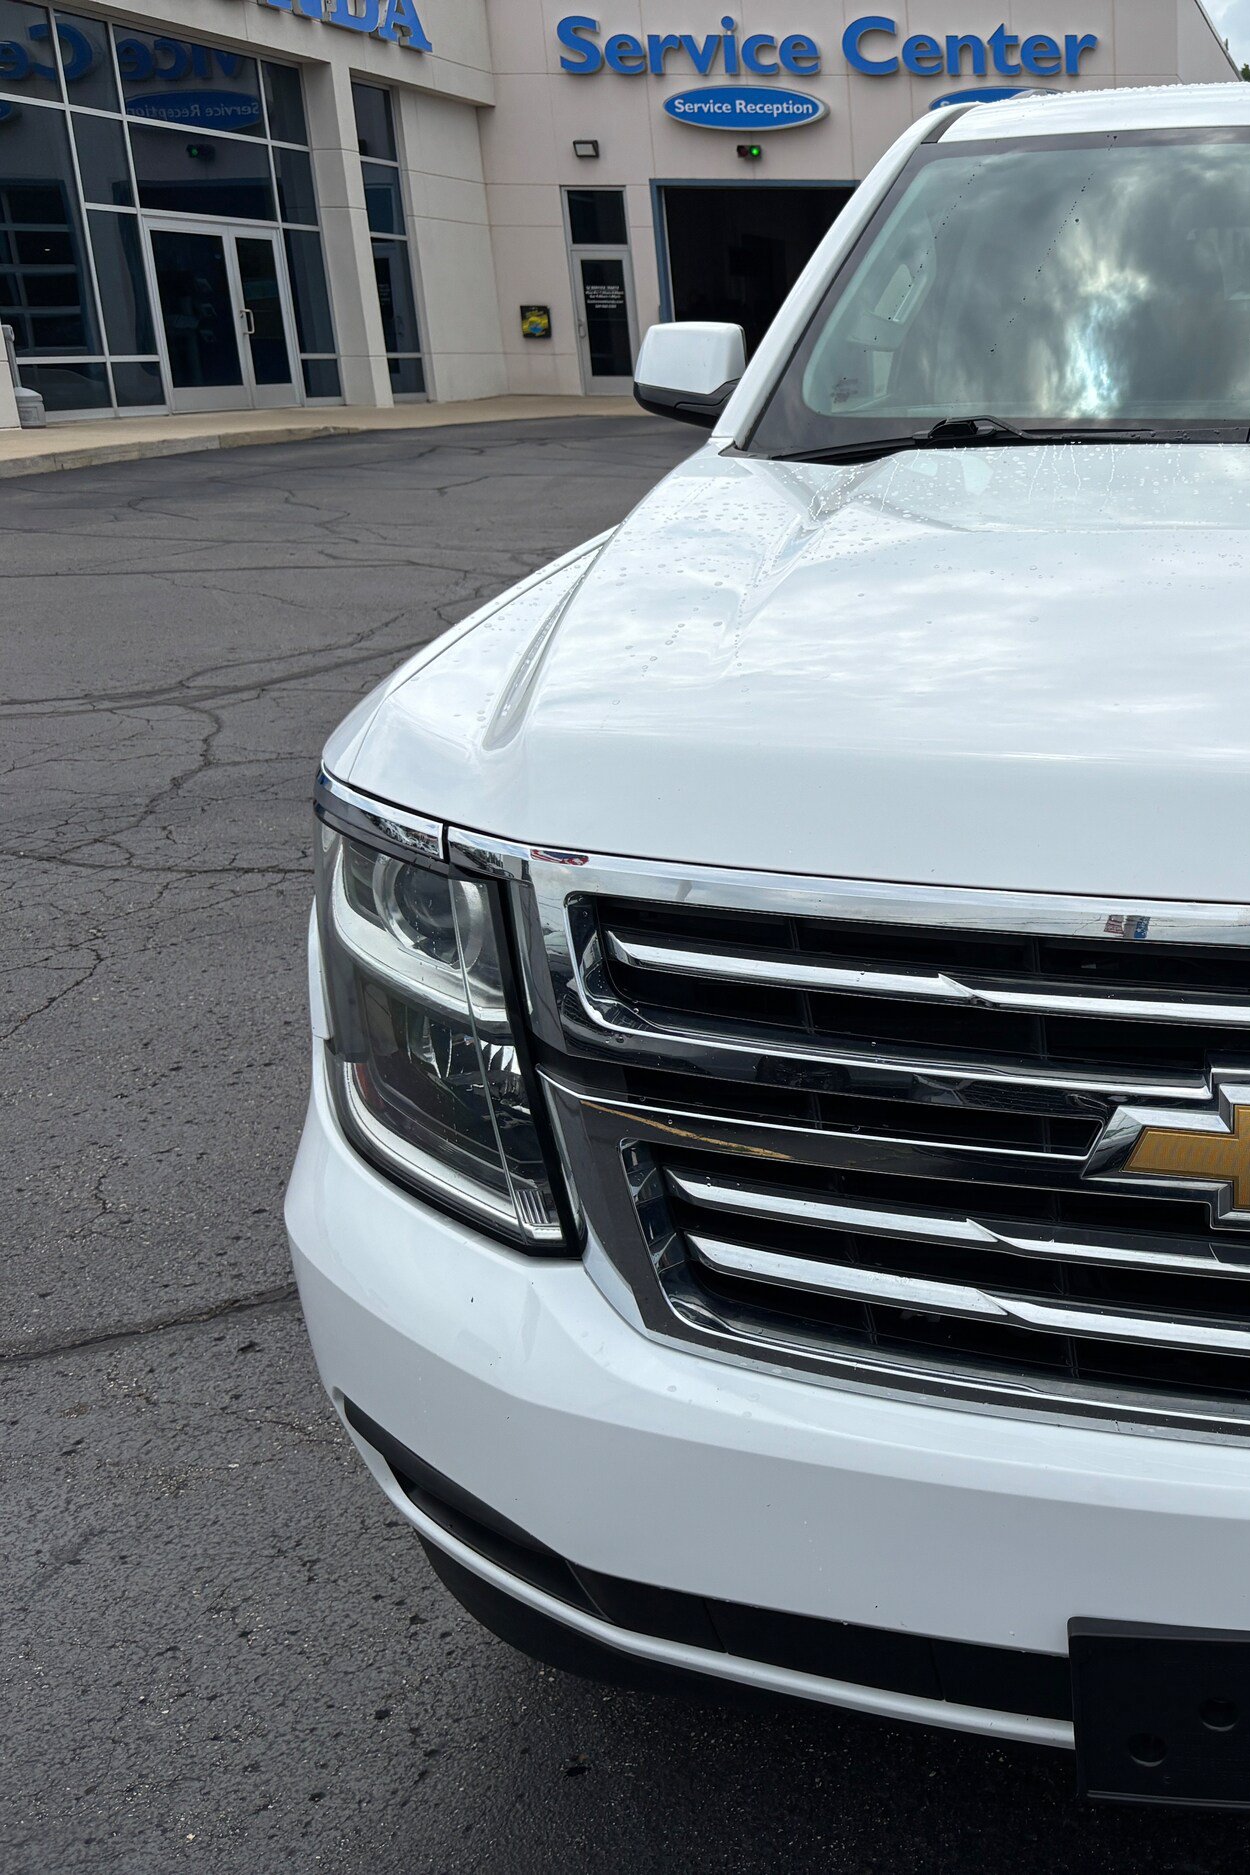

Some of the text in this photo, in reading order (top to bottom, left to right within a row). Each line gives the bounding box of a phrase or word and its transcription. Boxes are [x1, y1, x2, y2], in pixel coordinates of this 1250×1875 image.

[557, 15, 1098, 76] Service Center
[674, 99, 812, 118] Service Reception
